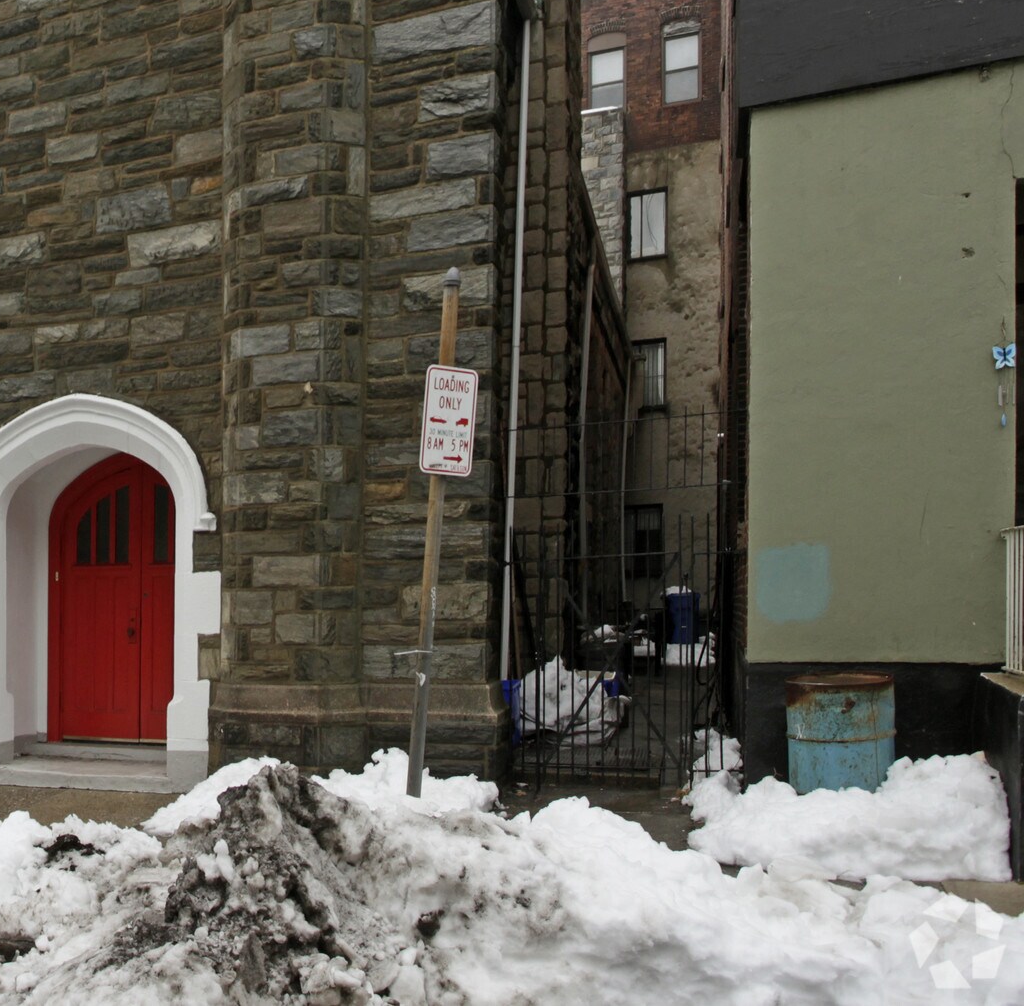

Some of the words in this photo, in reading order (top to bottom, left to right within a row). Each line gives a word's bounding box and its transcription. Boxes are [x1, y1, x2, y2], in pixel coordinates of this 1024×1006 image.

[434, 377, 470, 394] LOADING
[439, 395, 462, 411] ONLY
[427, 436, 432, 450] 8
[433, 437, 444, 450] AM
[451, 438, 456, 452] 5
[459, 439, 469, 452] PM
